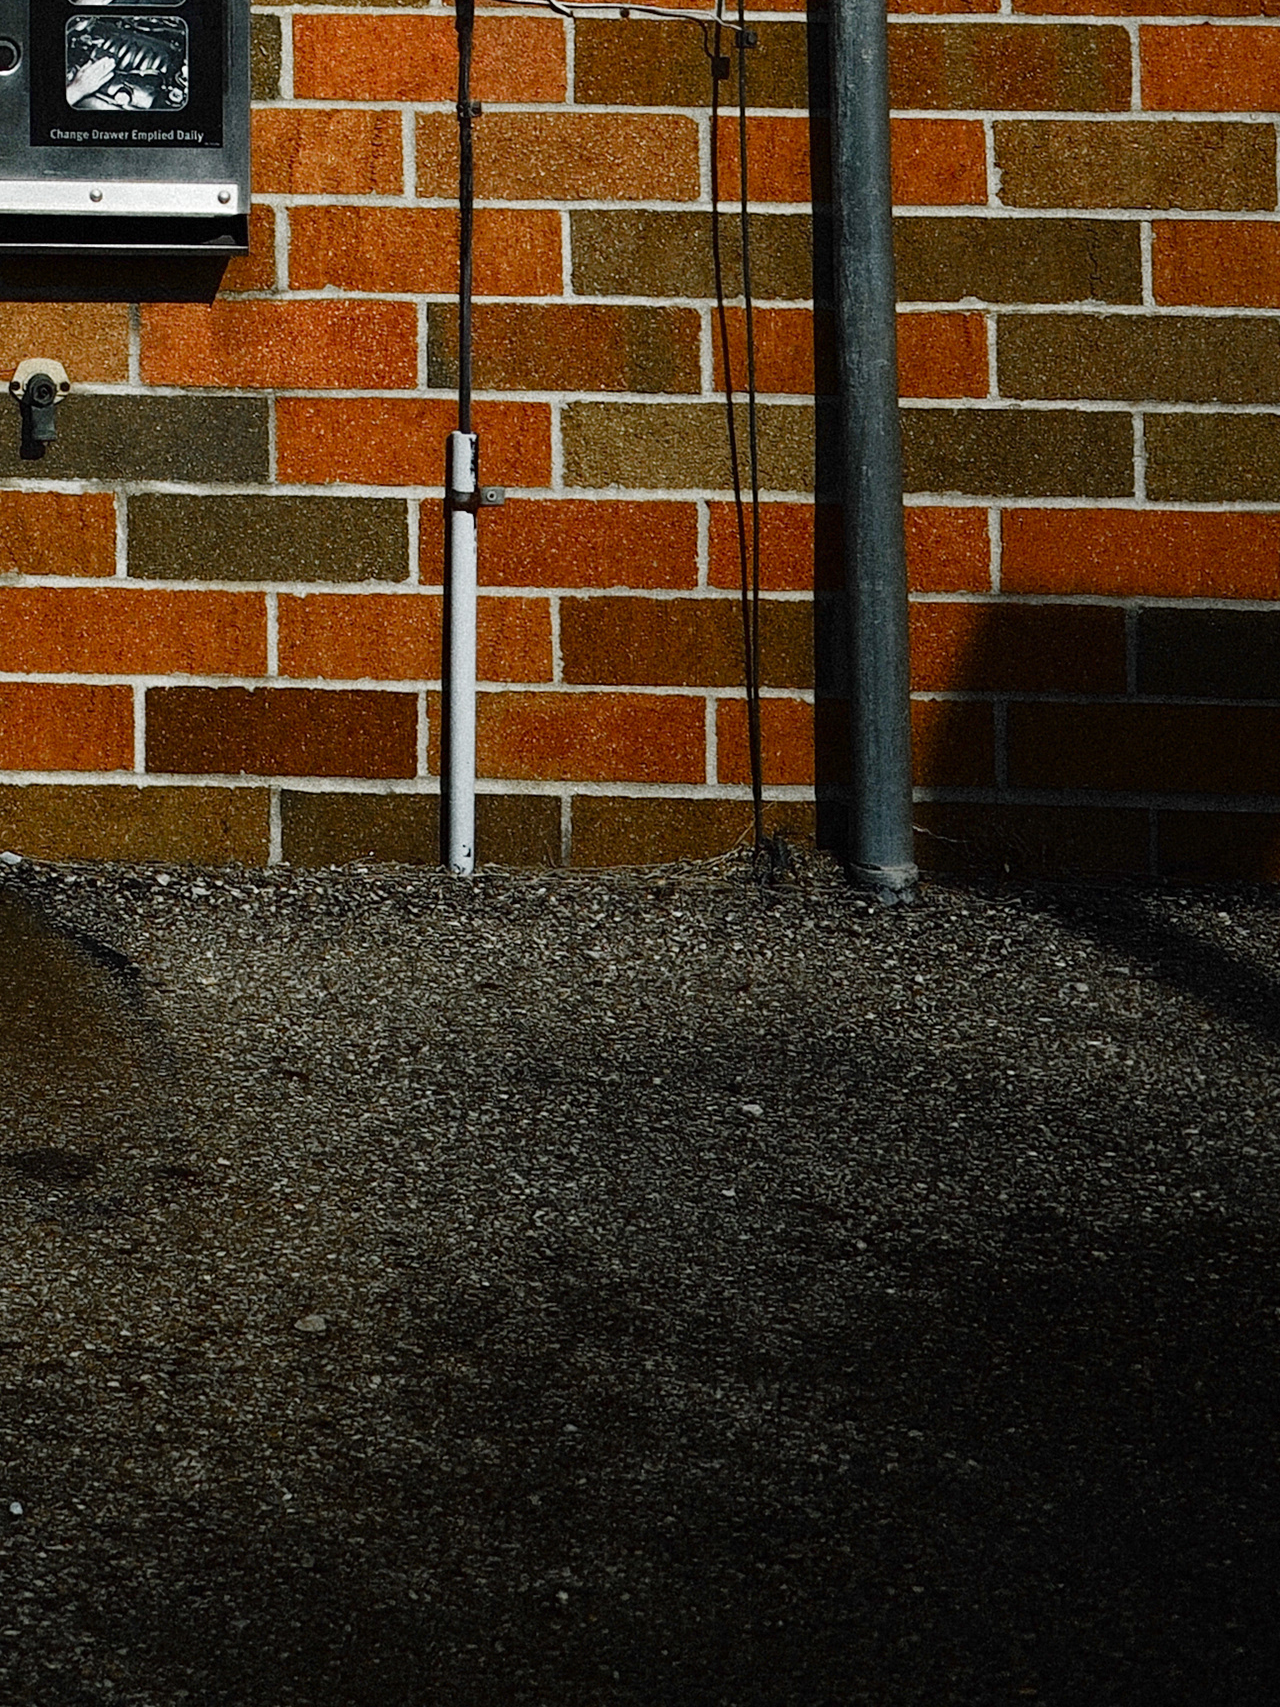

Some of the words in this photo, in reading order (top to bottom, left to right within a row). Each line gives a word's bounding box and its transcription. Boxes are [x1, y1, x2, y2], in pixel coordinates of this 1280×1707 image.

[49, 128, 90, 142] Change
[91, 129, 129, 140] Drawer
[176, 129, 205, 143] Daily
